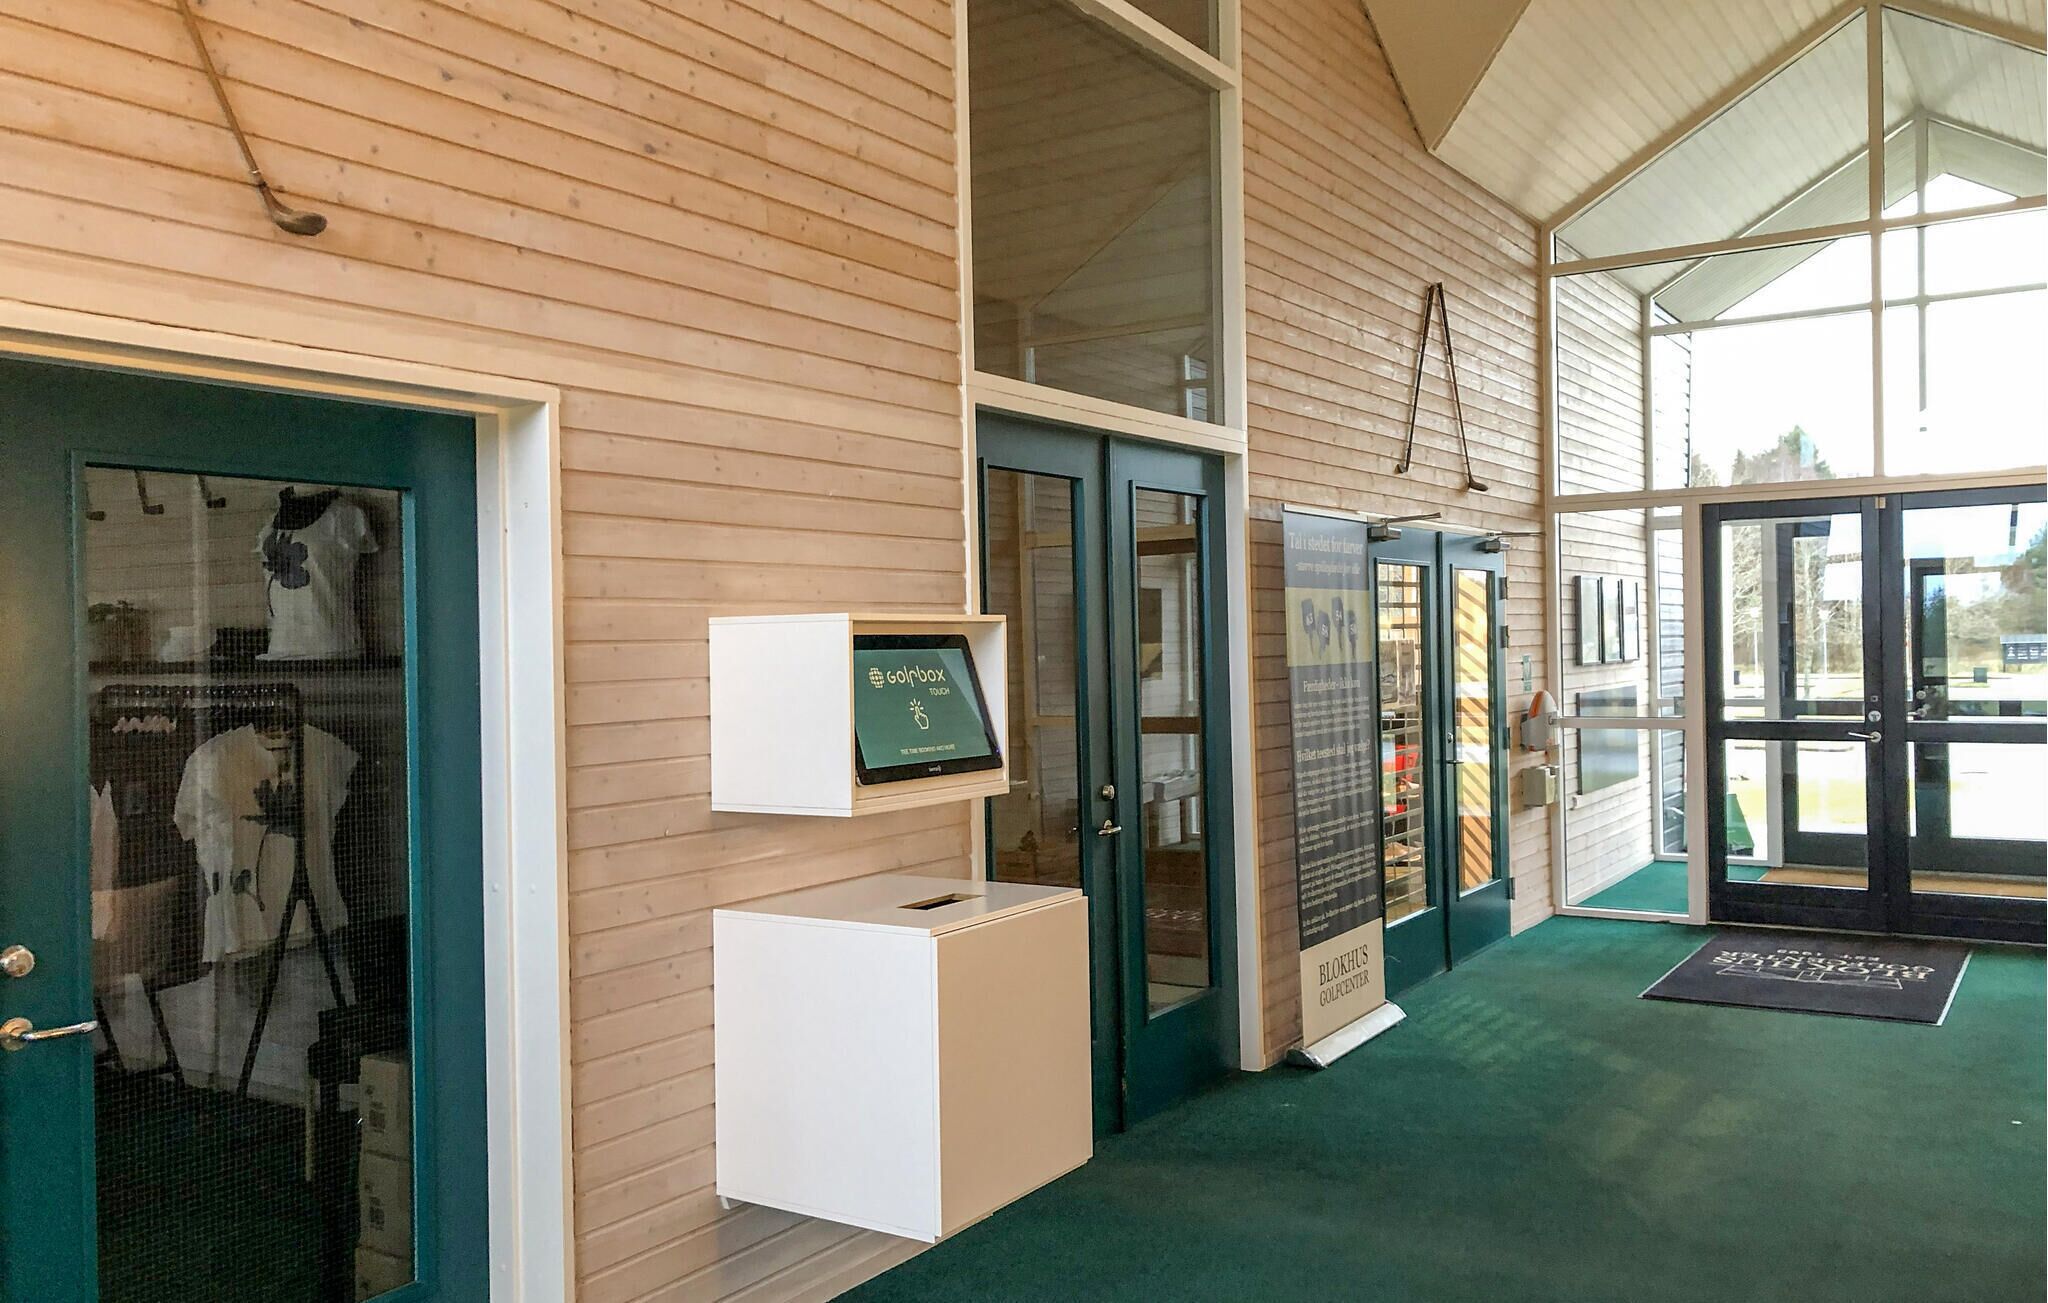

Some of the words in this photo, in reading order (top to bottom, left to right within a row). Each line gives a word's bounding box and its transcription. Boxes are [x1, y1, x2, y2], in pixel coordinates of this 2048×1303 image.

[928, 687, 951, 697] TOUCH
[1319, 944, 1369, 986] BLOKHUS
[1712, 955, 1928, 979] BLOKHUS
[1319, 969, 1370, 1007] GOLFCENTER
